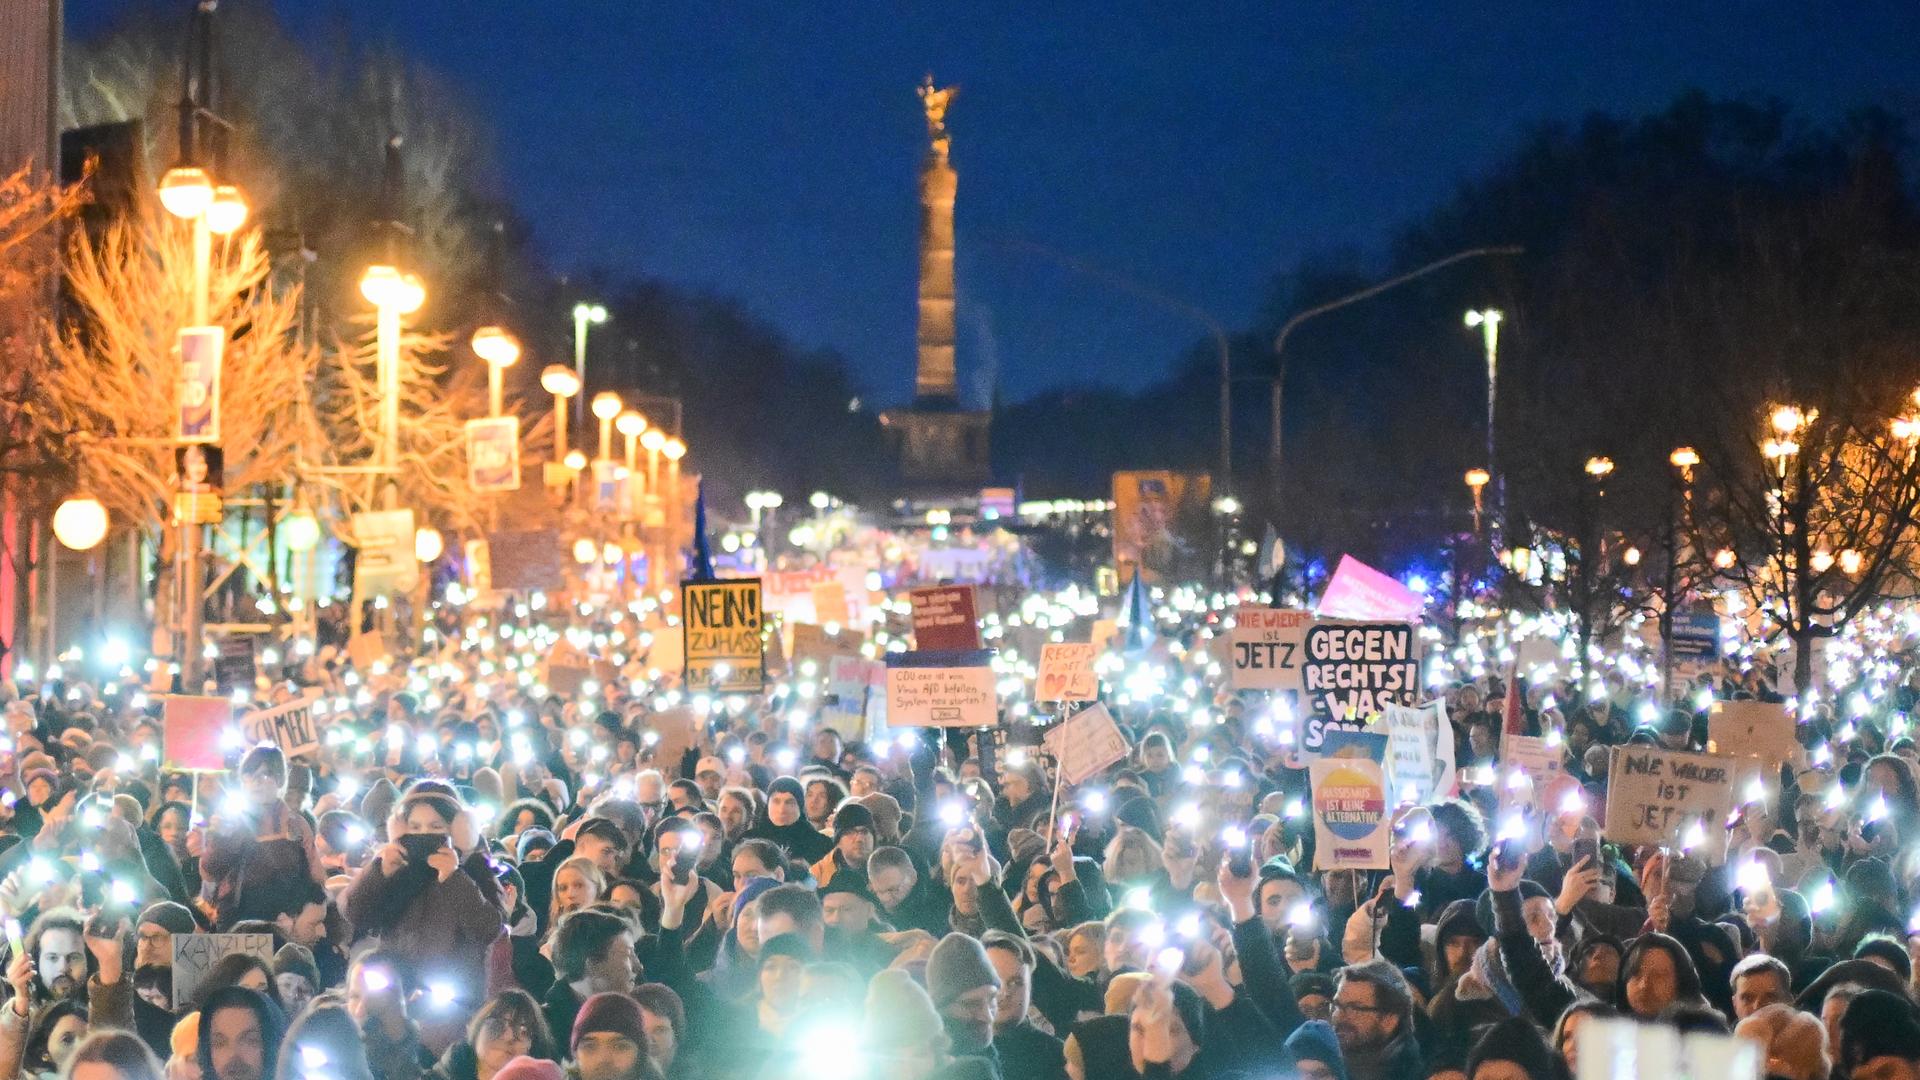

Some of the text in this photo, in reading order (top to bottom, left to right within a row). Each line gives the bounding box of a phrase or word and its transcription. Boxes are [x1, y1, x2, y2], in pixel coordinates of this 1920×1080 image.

[690, 588, 758, 629] NEIN!
[1234, 641, 1298, 670] JETZ
[1310, 629, 1408, 661] GEGEN
[922, 682, 940, 695] AfD
[1305, 662, 1417, 702] RECHTS!
[1326, 799, 1341, 811] IST
[1326, 811, 1379, 824] ALTERNATIVE
